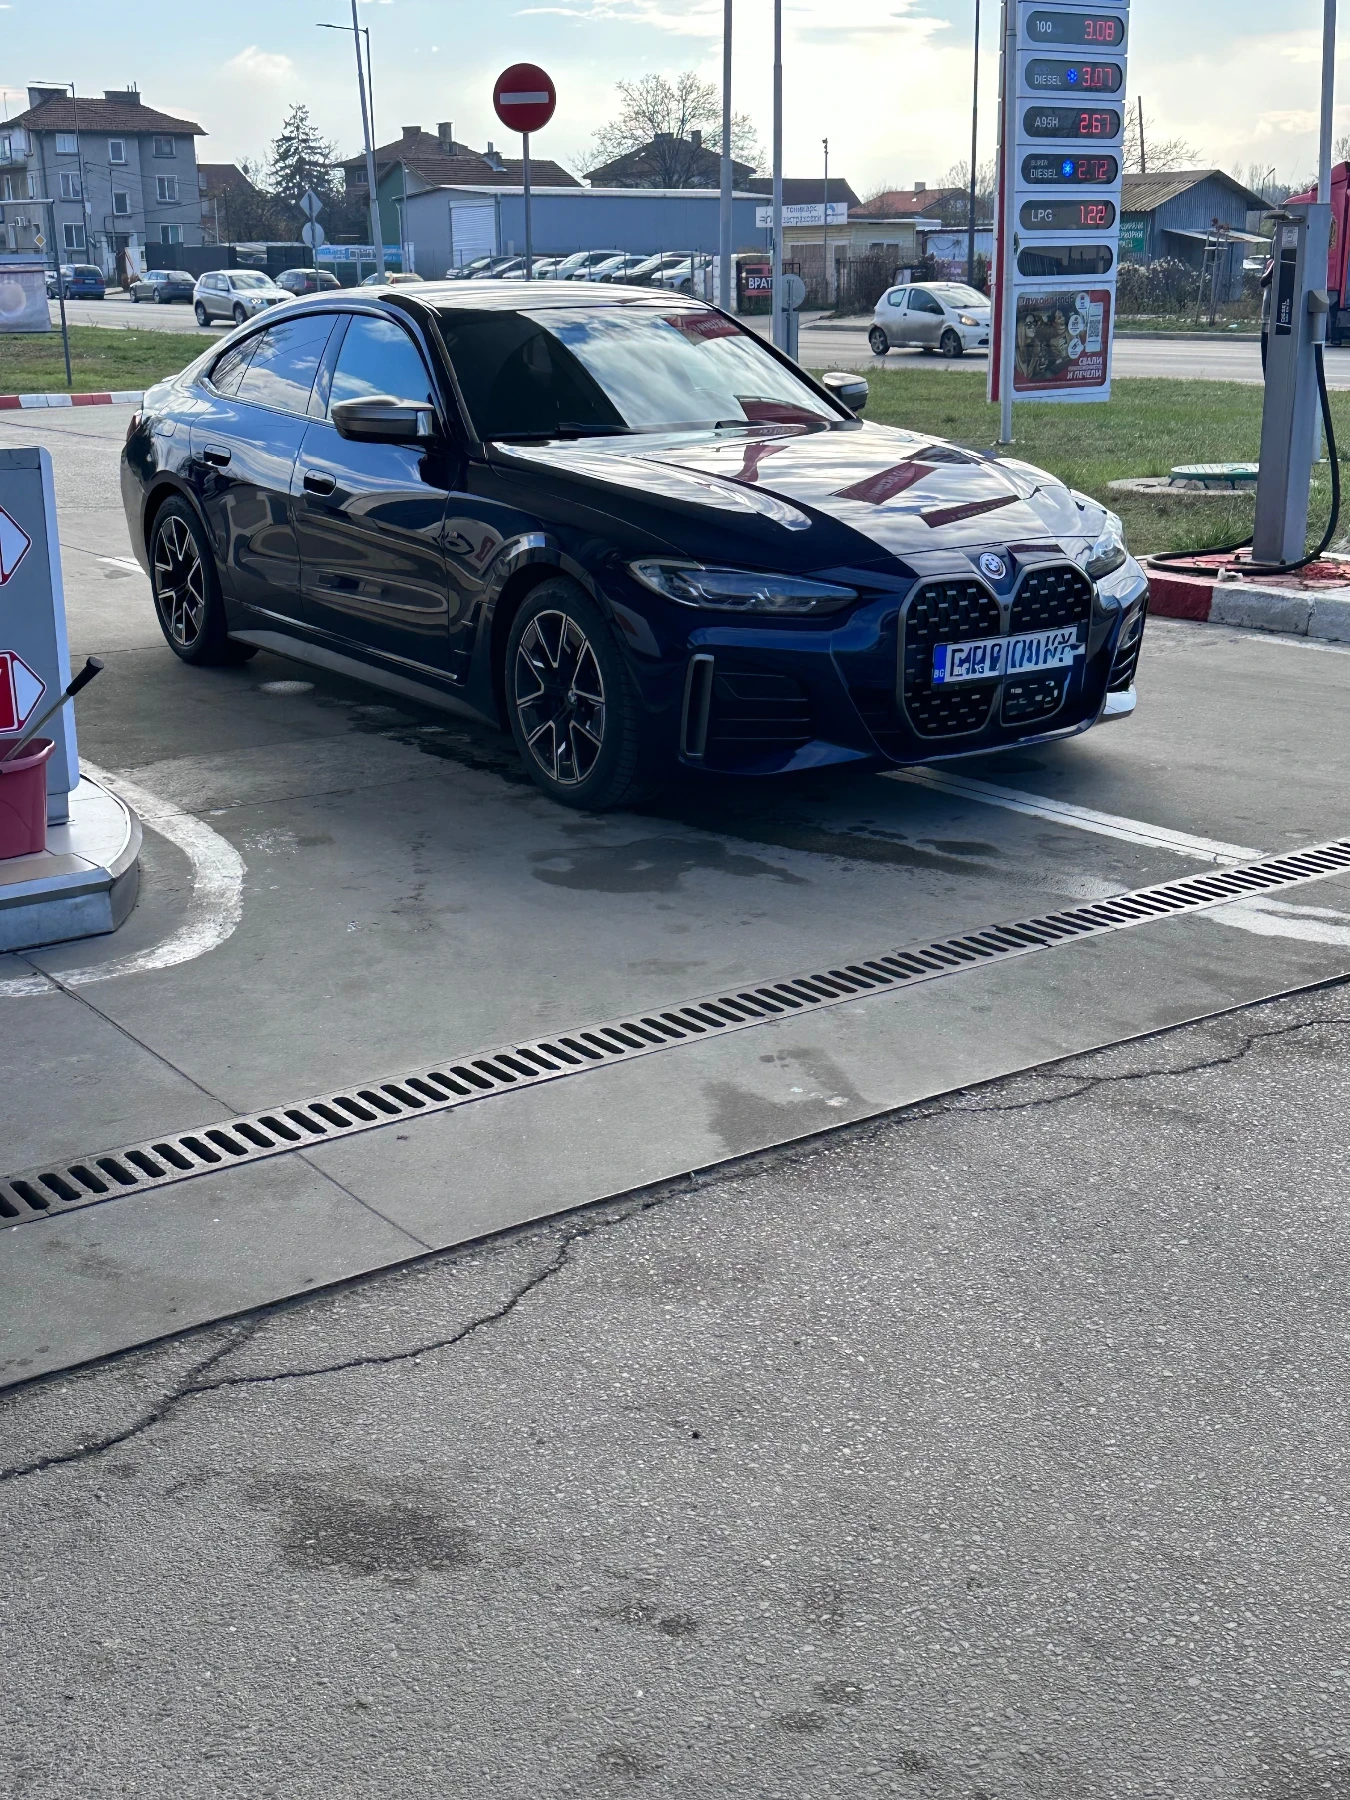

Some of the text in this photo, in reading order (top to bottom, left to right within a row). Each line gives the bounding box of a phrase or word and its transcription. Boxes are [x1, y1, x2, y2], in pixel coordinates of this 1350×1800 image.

[1036, 21, 1052, 33] 100
[1084, 20, 1114, 41] 3.08
[1034, 75, 1062, 85] DIESEL
[1082, 67, 1112, 87] 3.07
[1034, 116, 1059, 128] A95H
[1080, 114, 1110, 133] 2.67
[1030, 169, 1058, 178] DIESEL
[1078, 160, 1107, 178] 2.72
[1031, 209, 1053, 222] LPG
[1080, 205, 1106, 224] 1.22
[748, 277, 773, 289] ВРАТ
[1073, 369, 1102, 379] ПЕЧЕЛИ
[933, 669, 945, 679] BG
